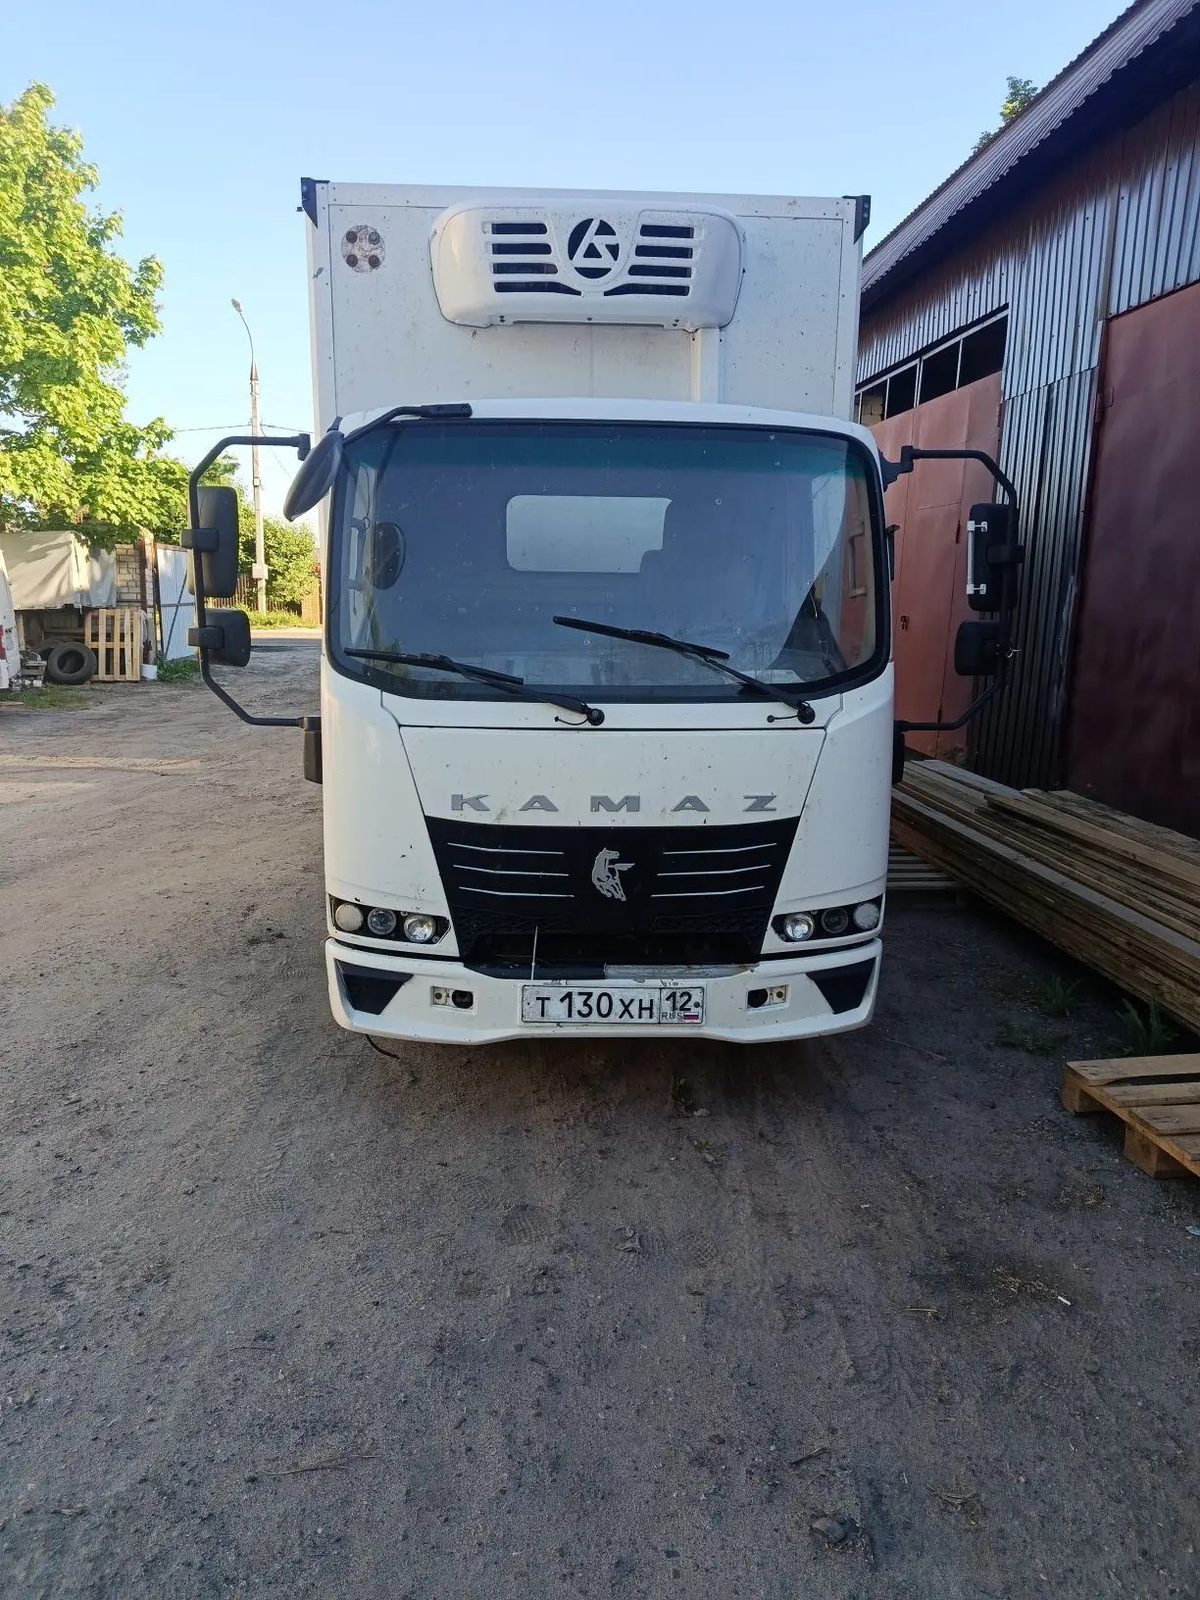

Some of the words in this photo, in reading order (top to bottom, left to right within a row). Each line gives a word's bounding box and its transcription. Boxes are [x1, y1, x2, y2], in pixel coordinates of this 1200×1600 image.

[451, 793, 777, 813] KAMAZ
[665, 991, 692, 1012] 12
[661, 1011, 683, 1020] RUS
